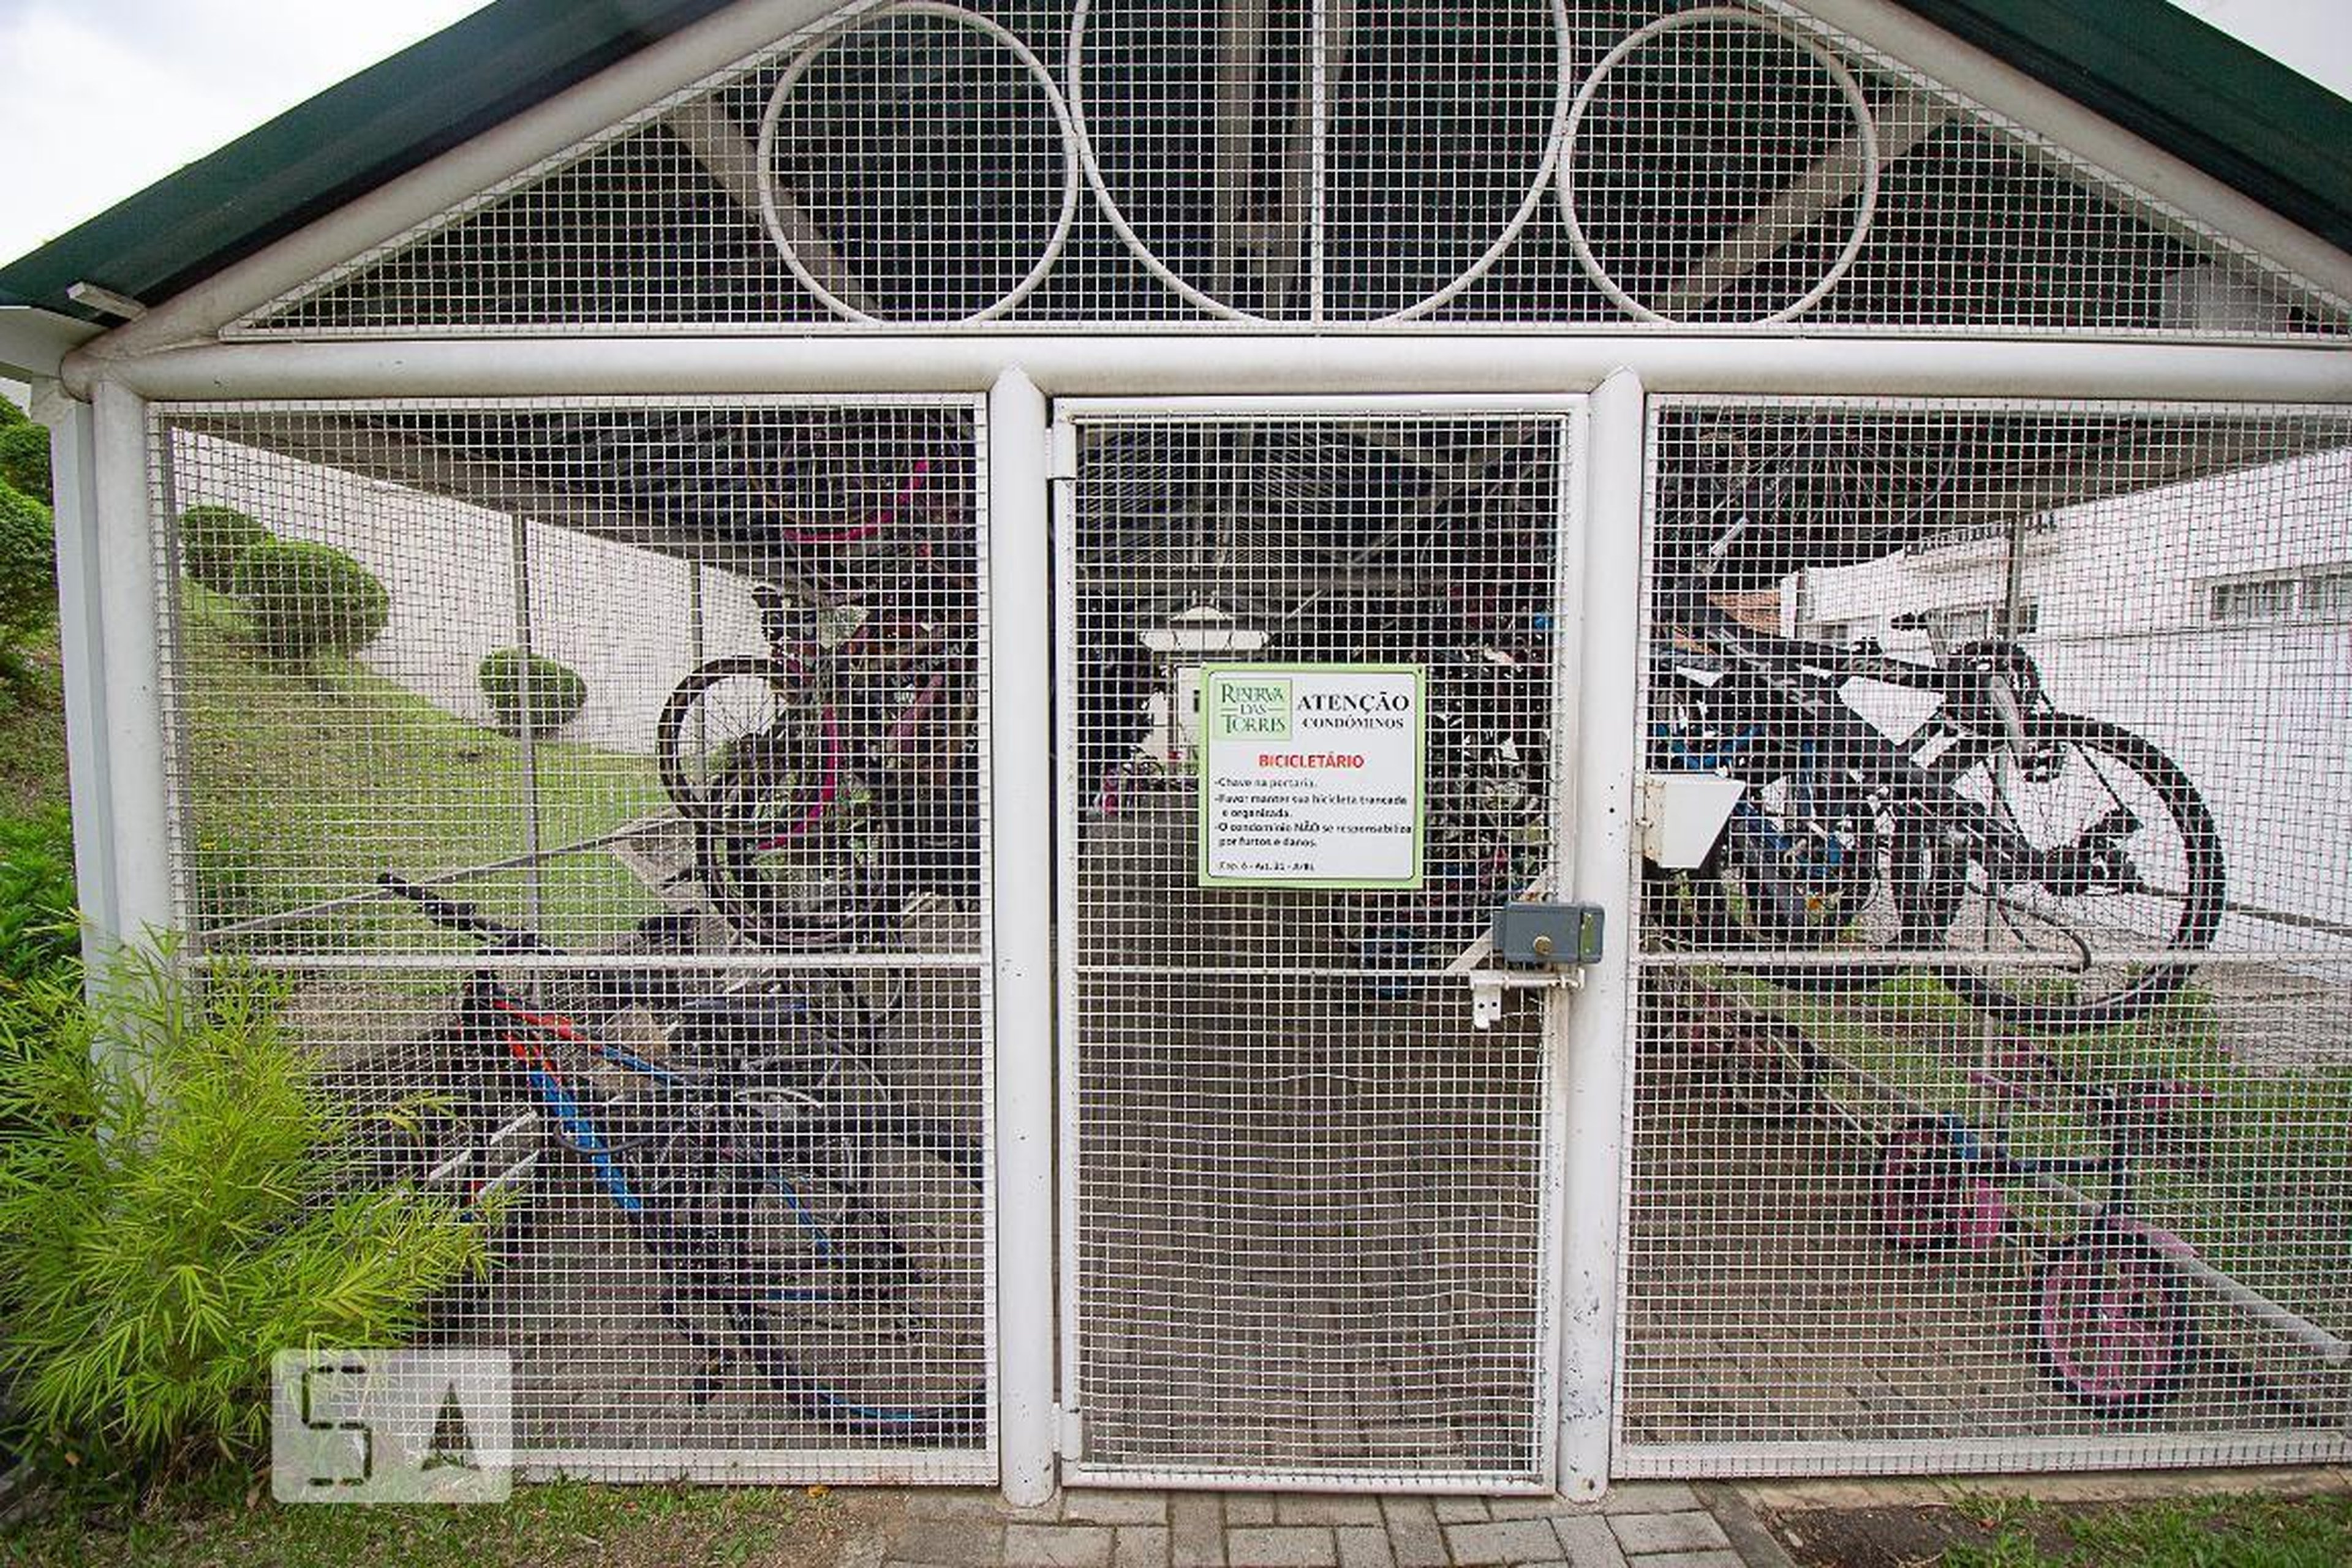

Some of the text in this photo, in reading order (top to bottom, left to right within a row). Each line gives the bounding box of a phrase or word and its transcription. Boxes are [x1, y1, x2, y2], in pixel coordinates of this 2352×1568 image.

[1297, 692, 1409, 714] ATENÇÃO
[1240, 704, 1267, 715] DAS
[1221, 714, 1285, 733] TORRES
[1259, 752, 1365, 768] BICICLETÁRIO
[1312, 794, 1358, 804] bicicleta
[1294, 820, 1319, 832] NÃO
[1219, 839, 1237, 847] por
